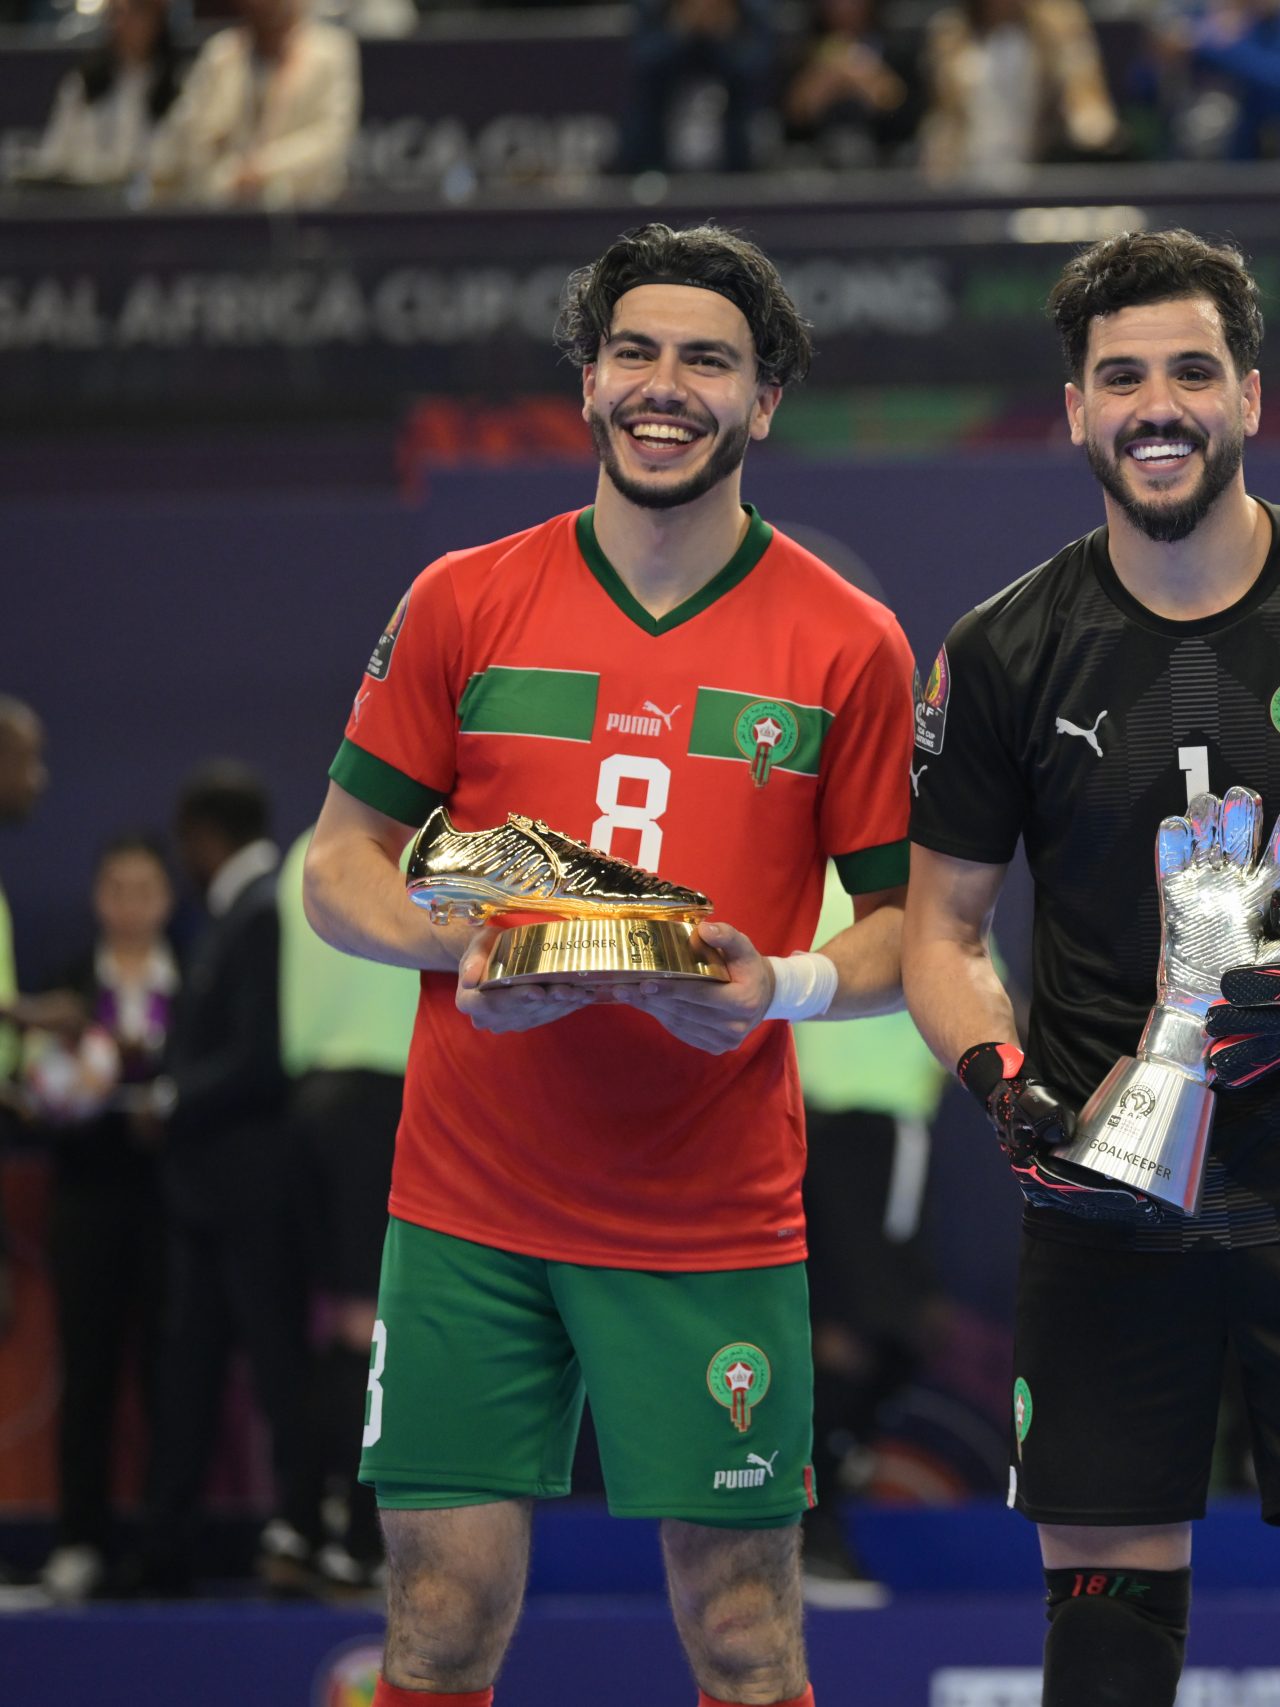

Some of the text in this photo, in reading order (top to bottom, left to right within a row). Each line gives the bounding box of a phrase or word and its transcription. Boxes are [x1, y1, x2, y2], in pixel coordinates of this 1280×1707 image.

[116, 272, 368, 346] AFRICA
[606, 712, 661, 737] PUMA
[590, 753, 671, 874] 8
[1089, 1138, 1172, 1181] GOALKEEPER
[713, 1468, 766, 1489] PUMA
